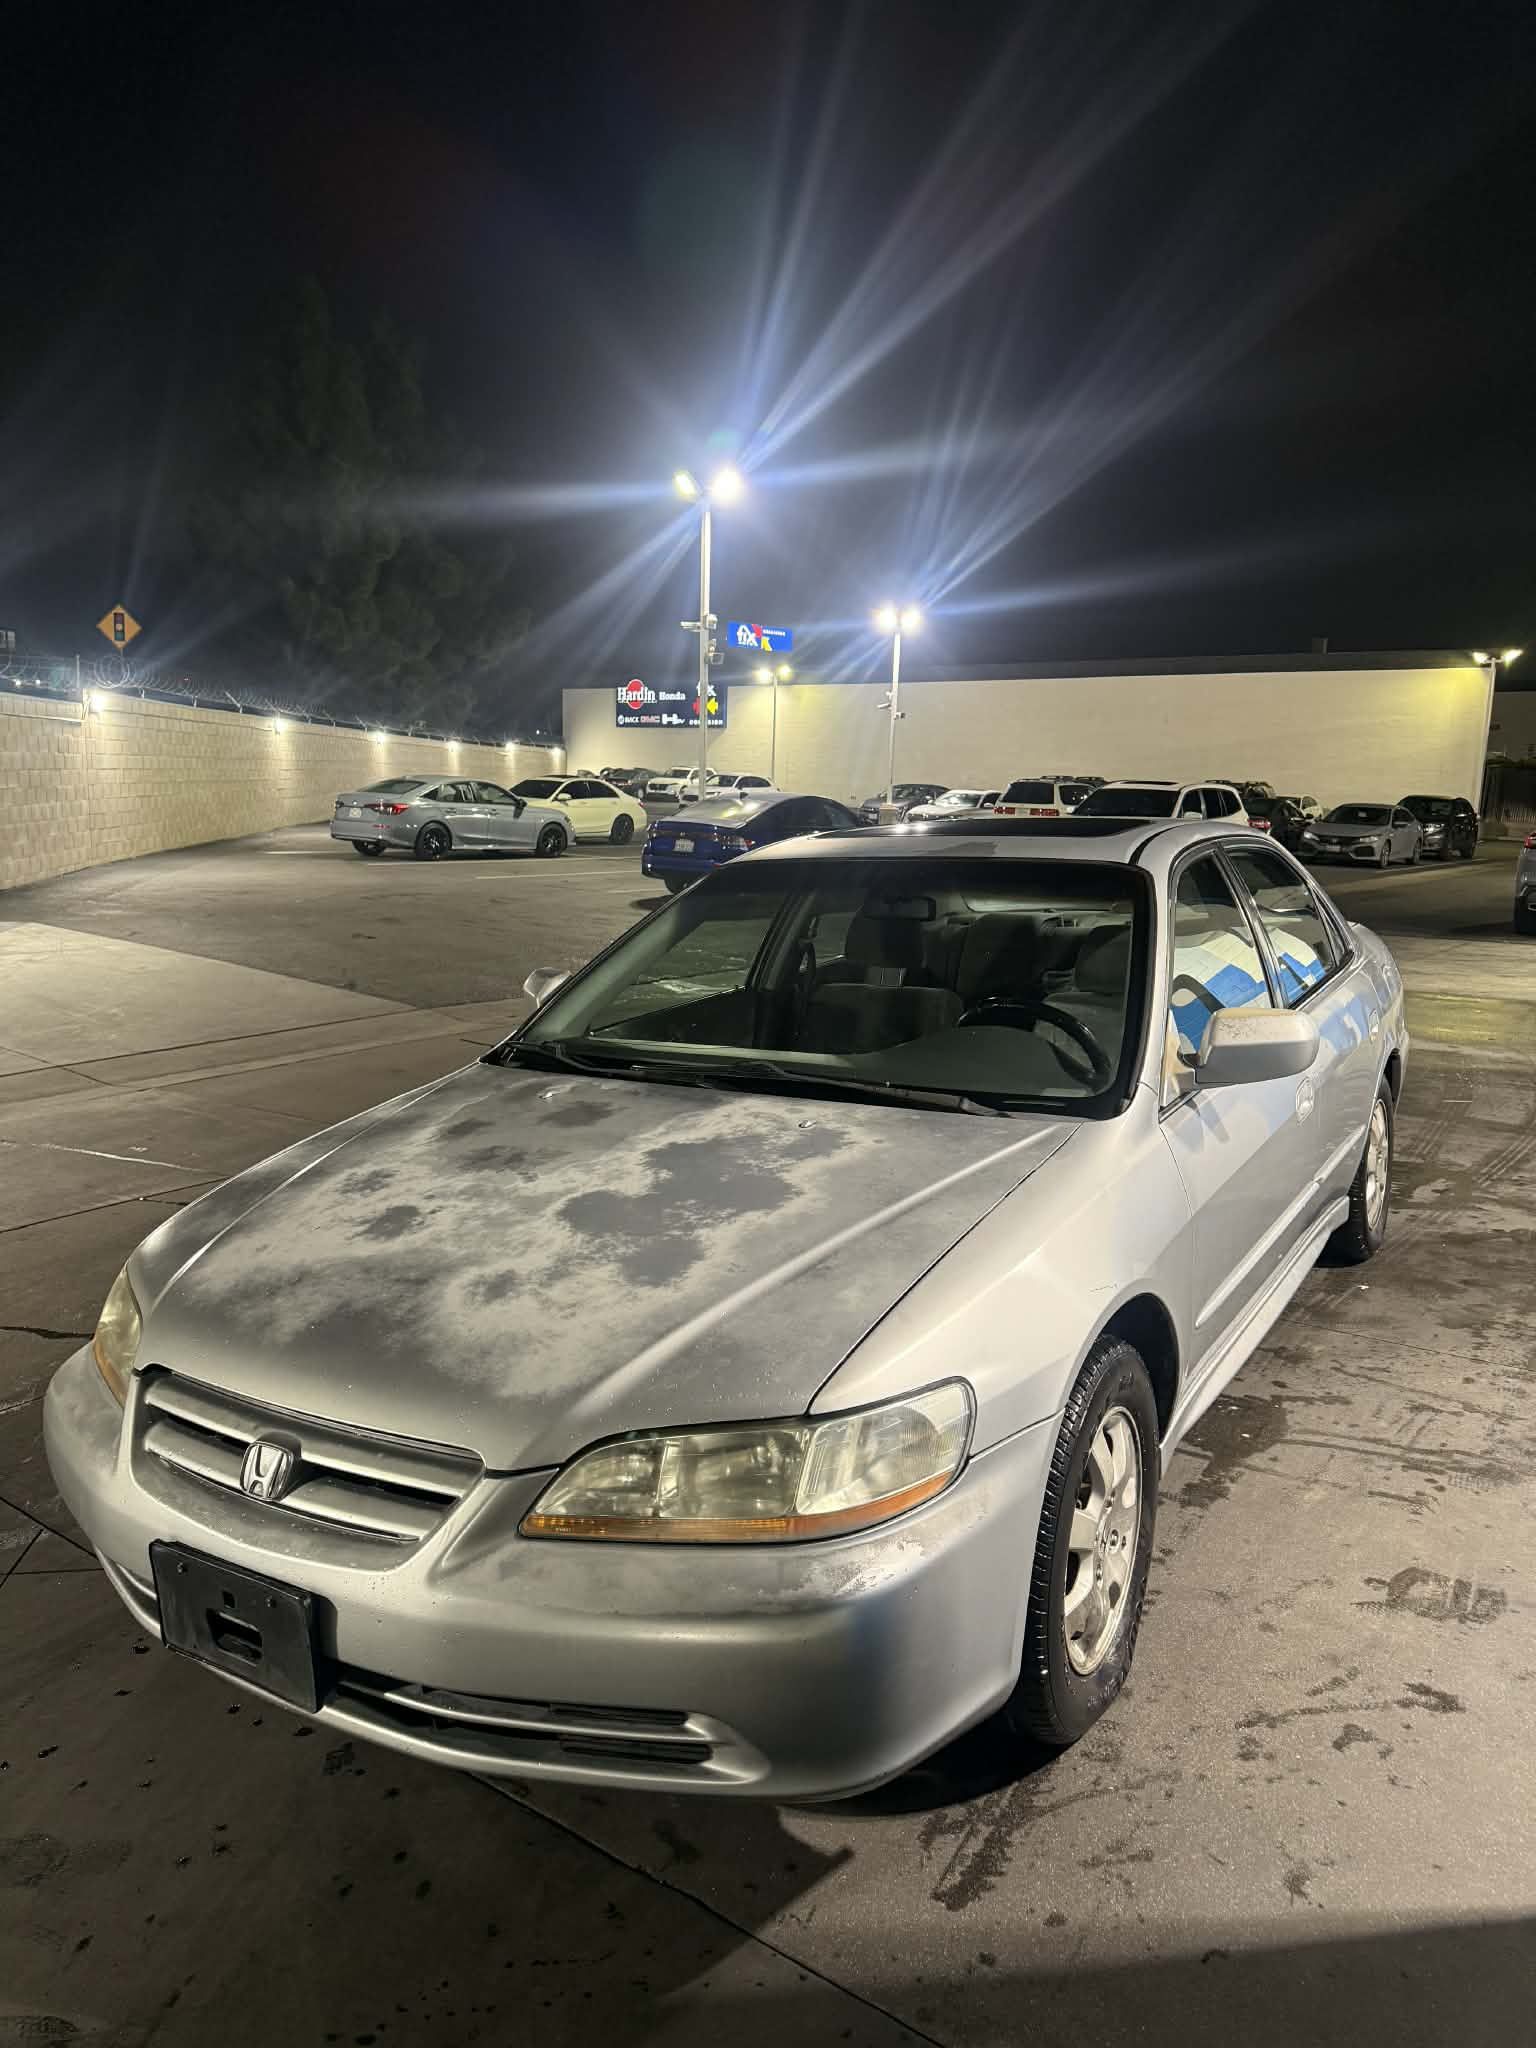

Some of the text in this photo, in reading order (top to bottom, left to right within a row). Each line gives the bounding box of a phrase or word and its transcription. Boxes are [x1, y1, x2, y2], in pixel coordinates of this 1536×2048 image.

[617, 686, 686, 701] Hardin Honda
[696, 680, 717, 697] fx
